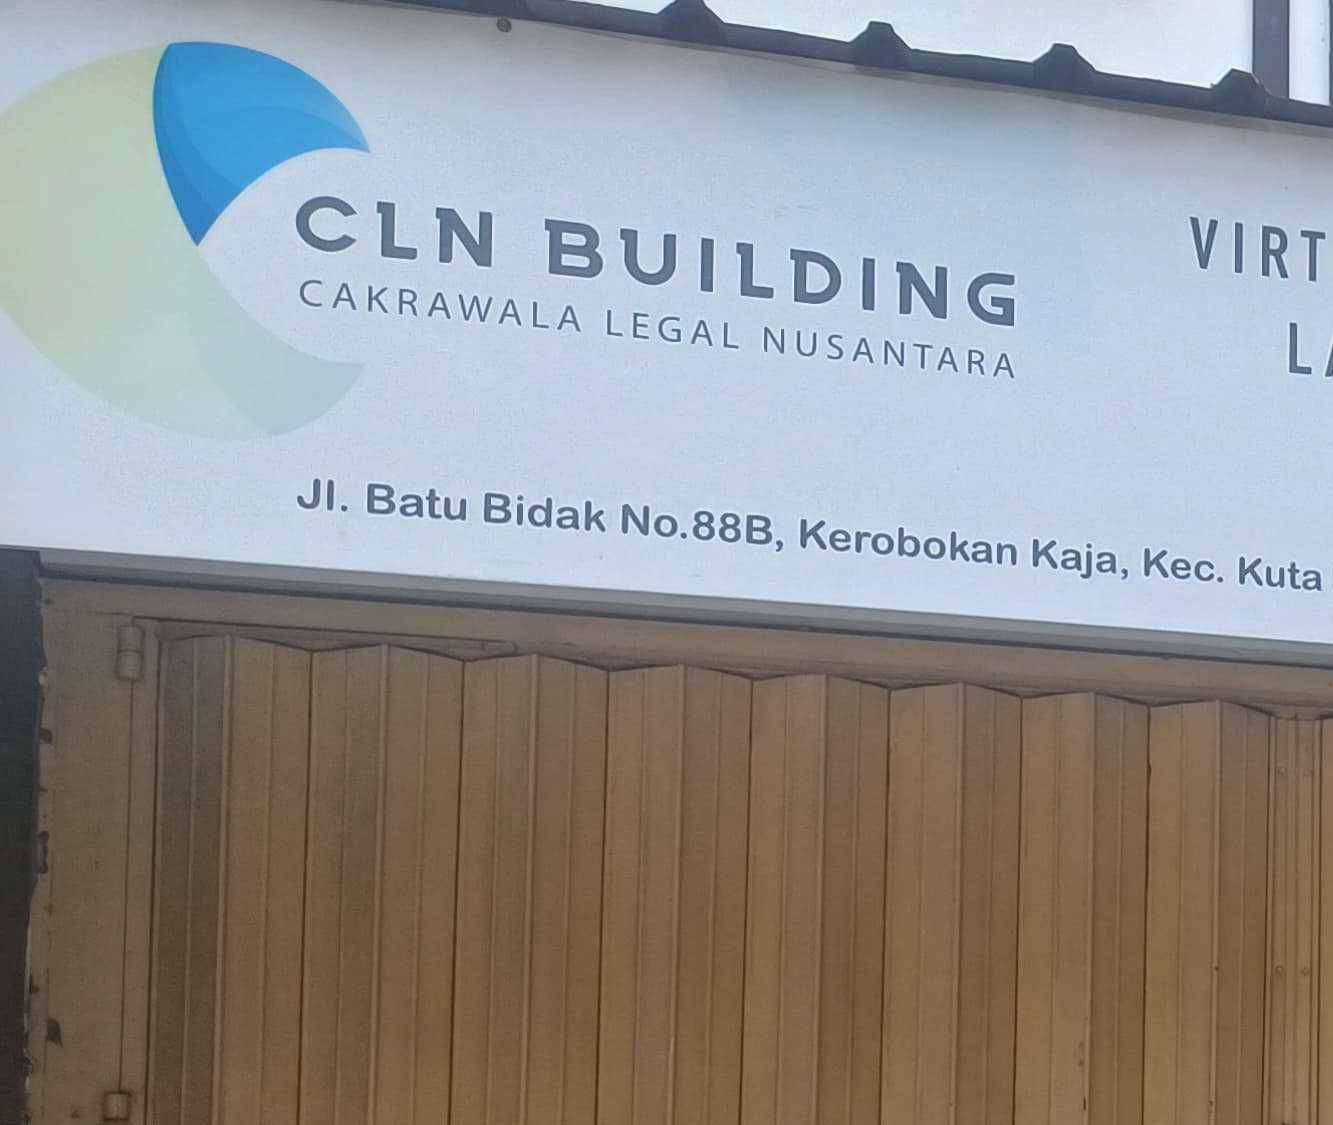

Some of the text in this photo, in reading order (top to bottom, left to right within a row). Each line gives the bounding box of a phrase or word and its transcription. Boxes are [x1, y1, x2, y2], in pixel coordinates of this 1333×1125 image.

[296, 196, 1015, 326] CLN BUILDING
[300, 280, 1014, 378] CAKRAWALA LEGAL NUSANTARA
[297, 479, 348, 512] Jl.
[367, 484, 466, 520] Batu
[484, 493, 606, 532] Bidak
[622, 504, 783, 552] No.88B,
[800, 519, 1017, 565] Kerobokan
[1033, 539, 1128, 580] Kaja,
[1144, 548, 1223, 583] Kec.
[1239, 557, 1322, 591] Kuta
